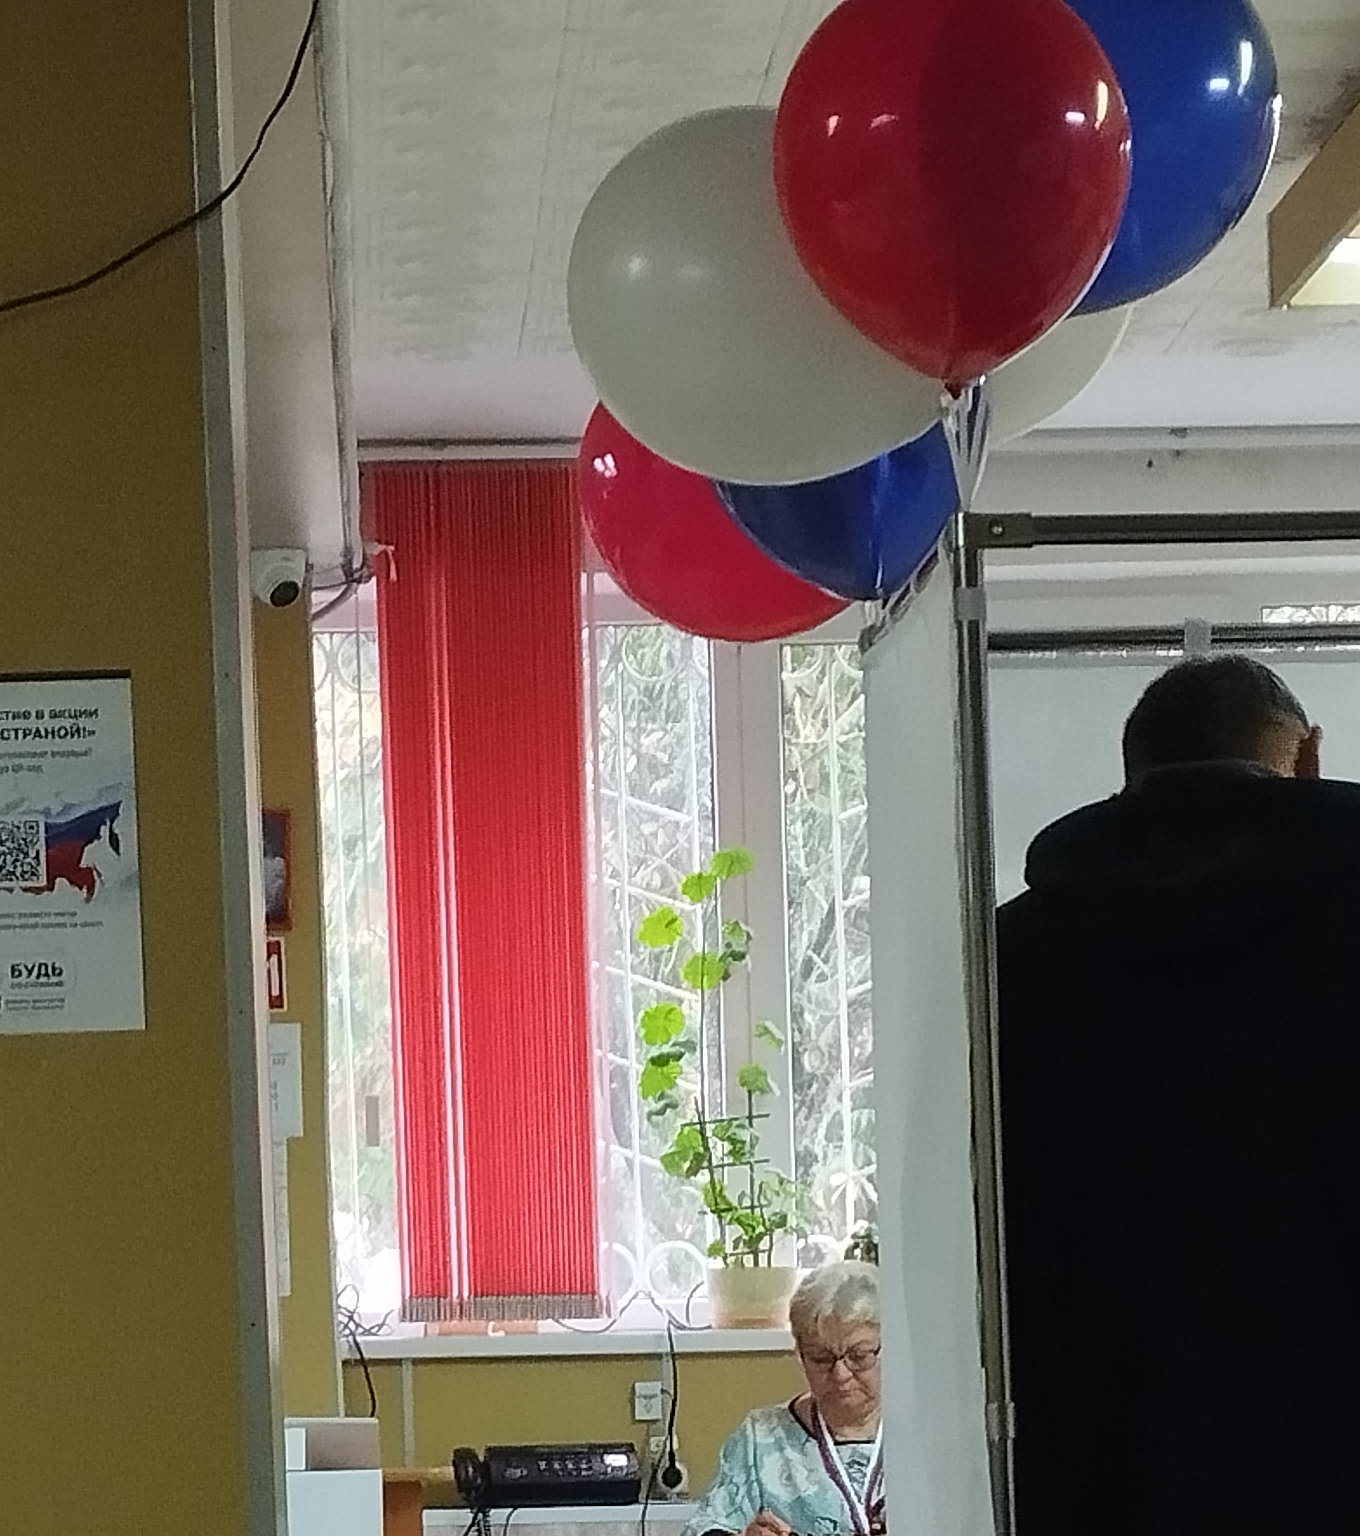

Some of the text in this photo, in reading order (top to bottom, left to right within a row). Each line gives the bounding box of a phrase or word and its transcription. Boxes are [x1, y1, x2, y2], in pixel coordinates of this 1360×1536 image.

[35, 709, 45, 720] в
[48, 707, 99, 722] акции
[10, 961, 64, 980] БУДЬ
